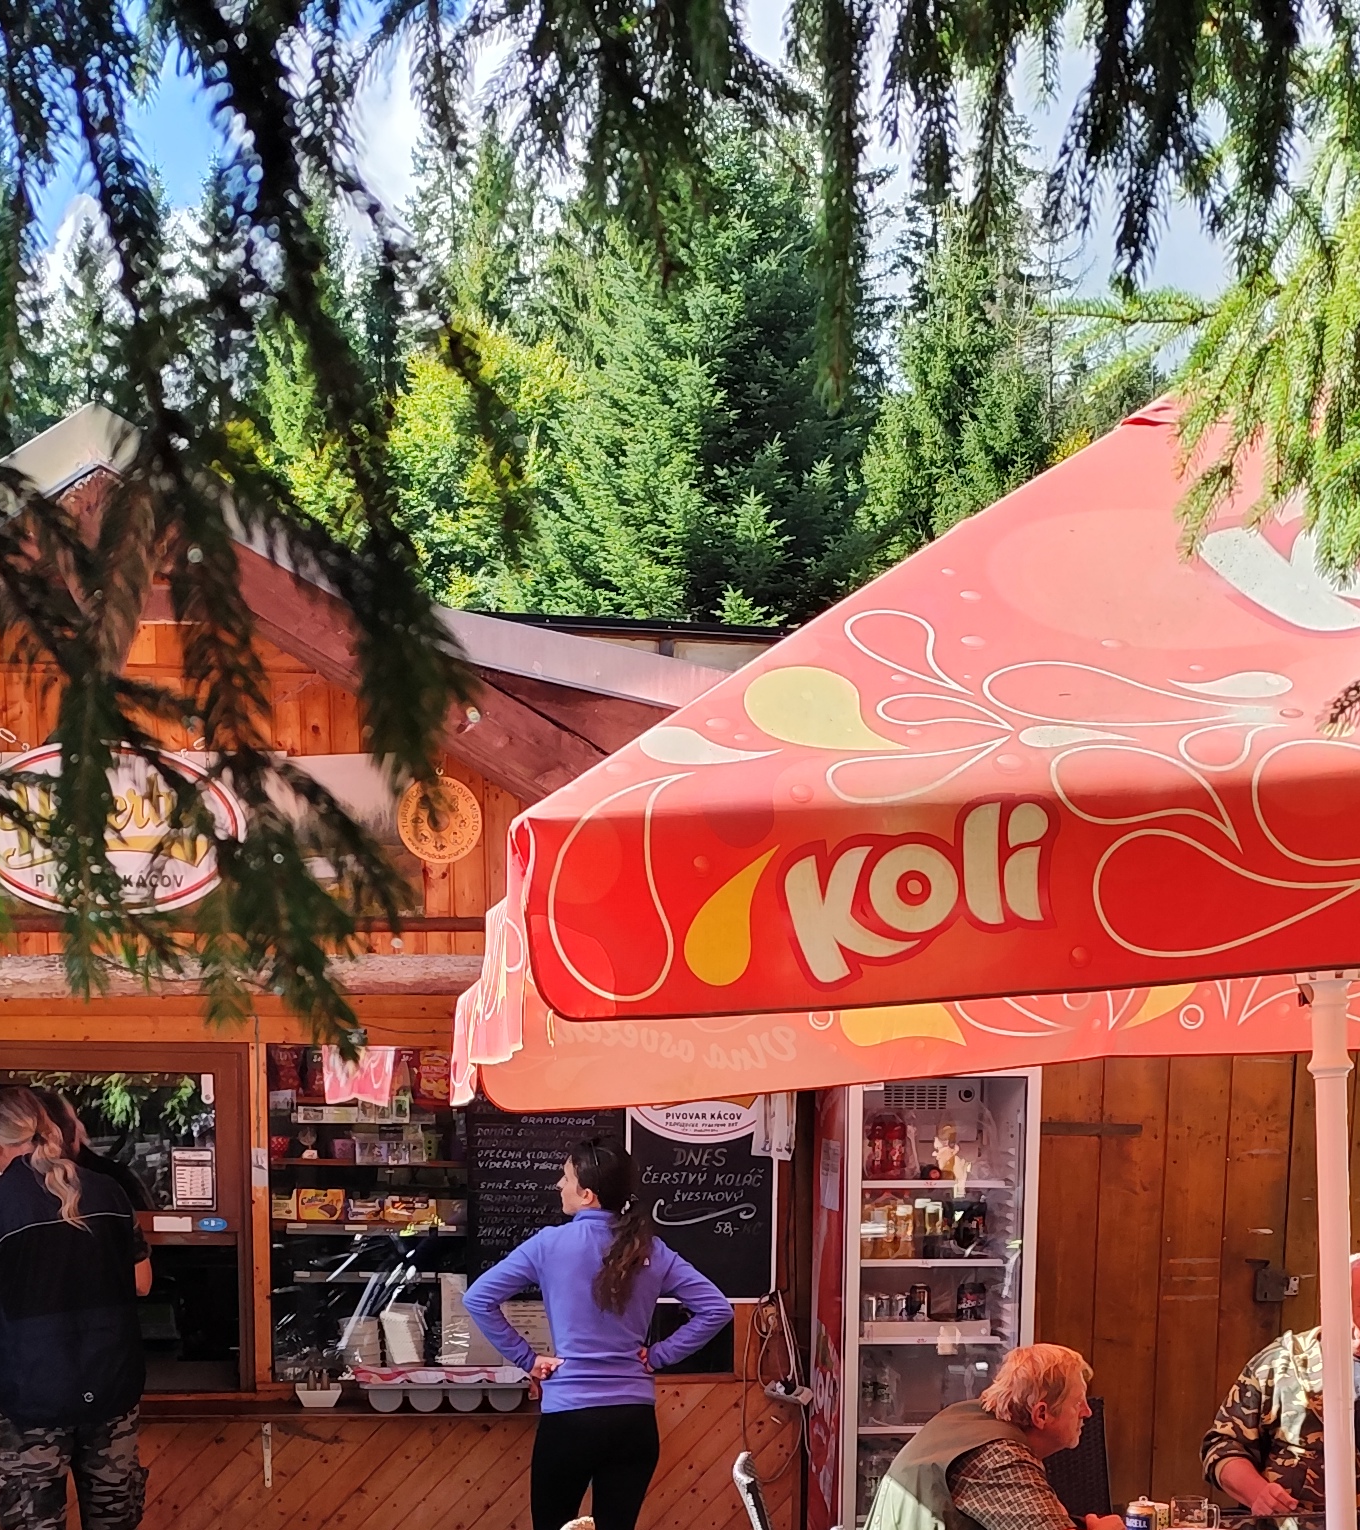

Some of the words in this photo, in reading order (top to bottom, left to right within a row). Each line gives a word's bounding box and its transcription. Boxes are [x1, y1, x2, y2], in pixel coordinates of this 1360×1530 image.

[401, 786, 423, 829] TURISTICK
[665, 1112, 707, 1120] PIVOVAR
[710, 1110, 742, 1120] KÁCOV
[672, 1147, 728, 1167] DNES
[641, 1165, 707, 1186] ČERSTVÝ
[713, 1168, 765, 1187] KOLÁČ
[674, 1189, 744, 1202] ŠVESTKOVÝ
